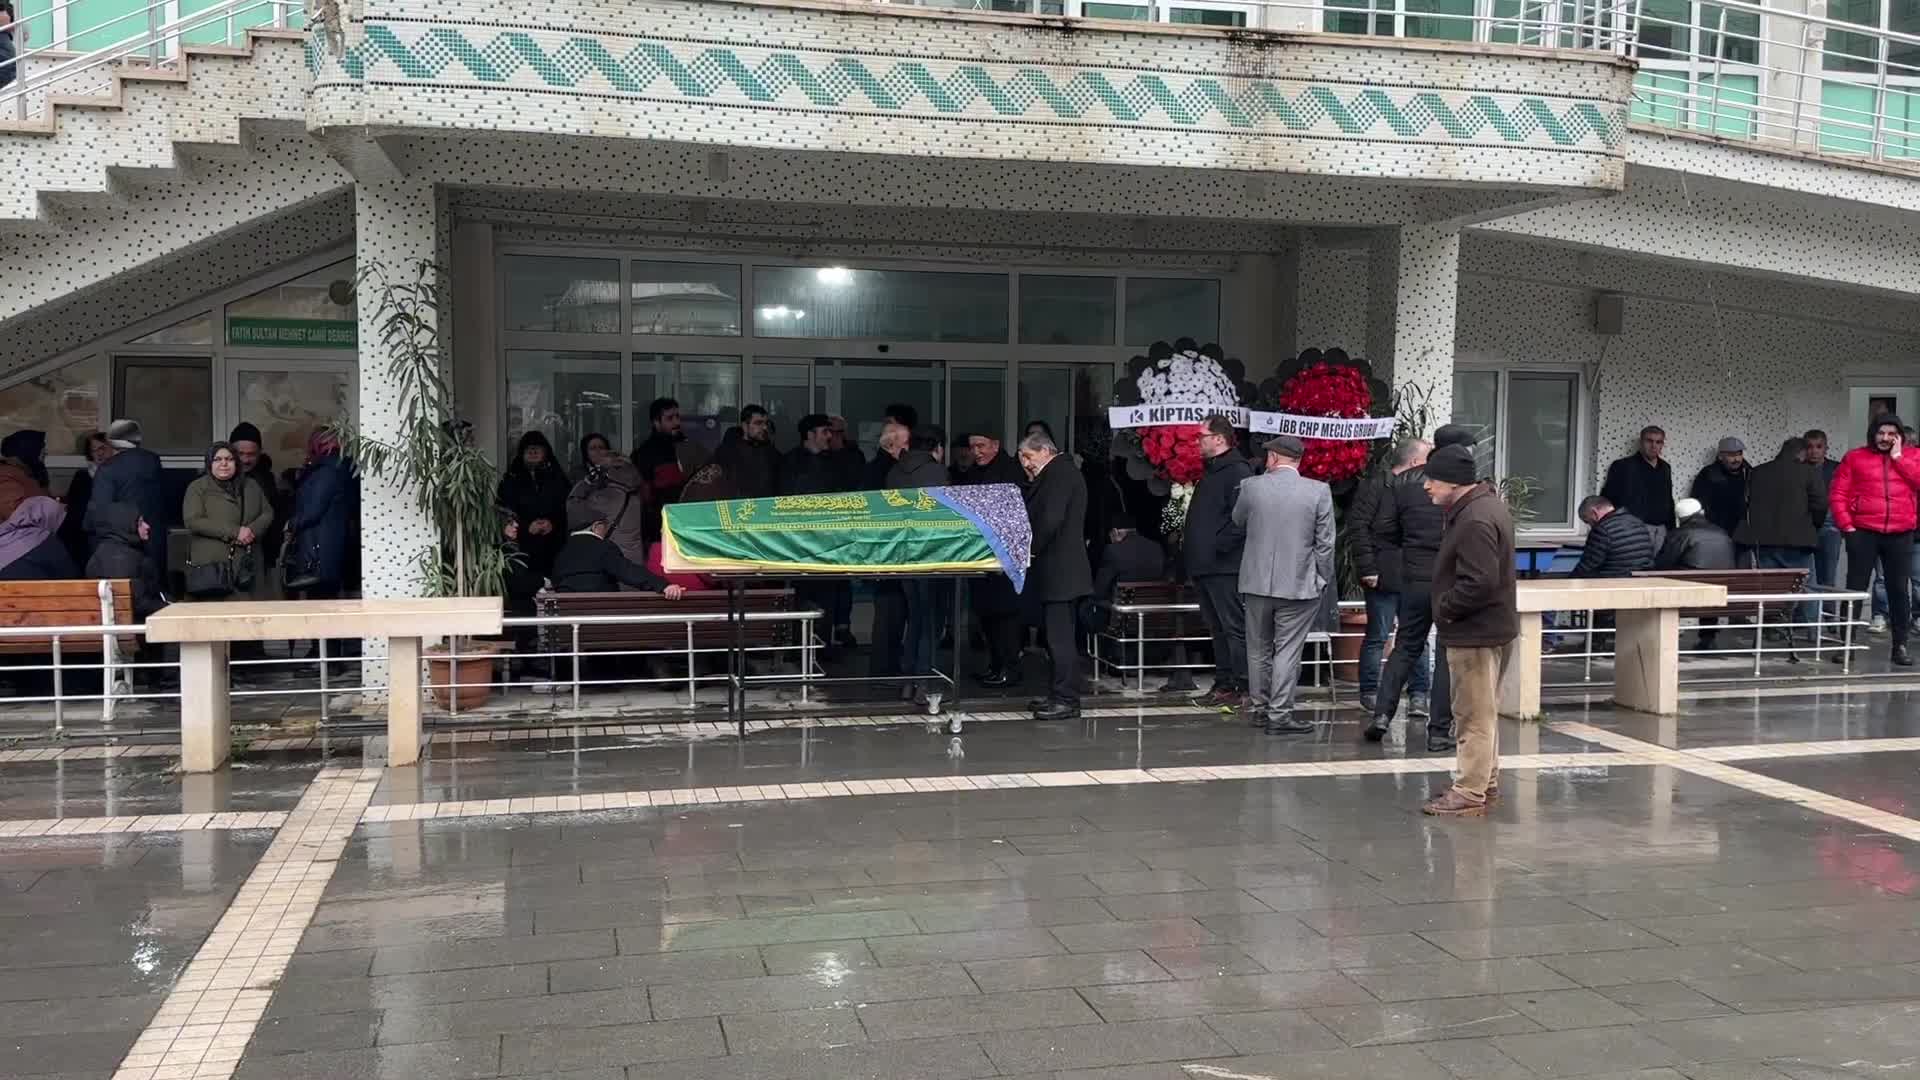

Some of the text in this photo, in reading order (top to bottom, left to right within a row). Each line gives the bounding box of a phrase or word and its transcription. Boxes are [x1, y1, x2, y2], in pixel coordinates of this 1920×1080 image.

[251, 328, 277, 340] SULTAN
[278, 328, 306, 341] MEHMET
[1279, 415, 1378, 438] İBB CHP MECLİS GRUBU
